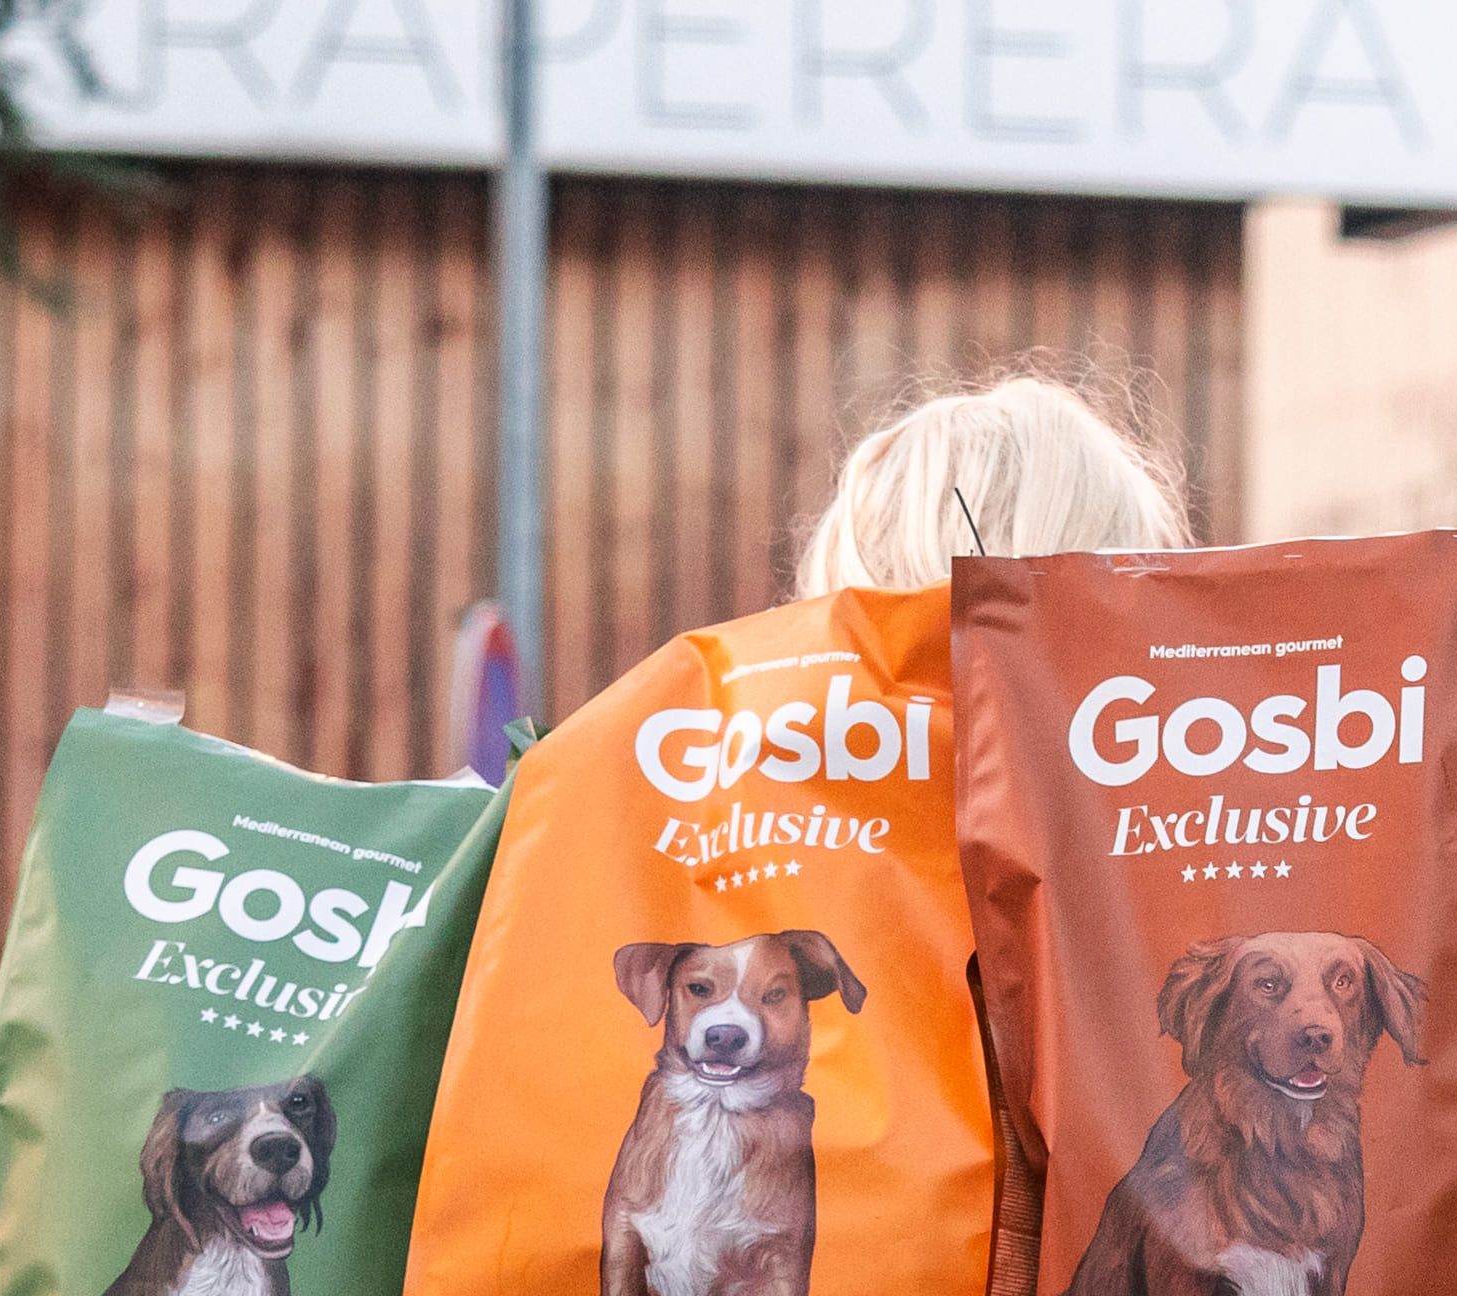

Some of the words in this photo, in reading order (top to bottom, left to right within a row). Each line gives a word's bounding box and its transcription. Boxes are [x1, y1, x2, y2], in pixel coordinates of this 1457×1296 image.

[1149, 643, 1272, 659] Mediterranean
[1275, 634, 1344, 657] gourmet
[634, 674, 936, 803] Gosbi
[1068, 654, 1428, 787] Gosbi
[232, 814, 351, 855] Mediterranean
[352, 846, 423, 875] gourmet
[652, 801, 891, 867] Exclusive
[1108, 794, 1377, 856] Exclusive
